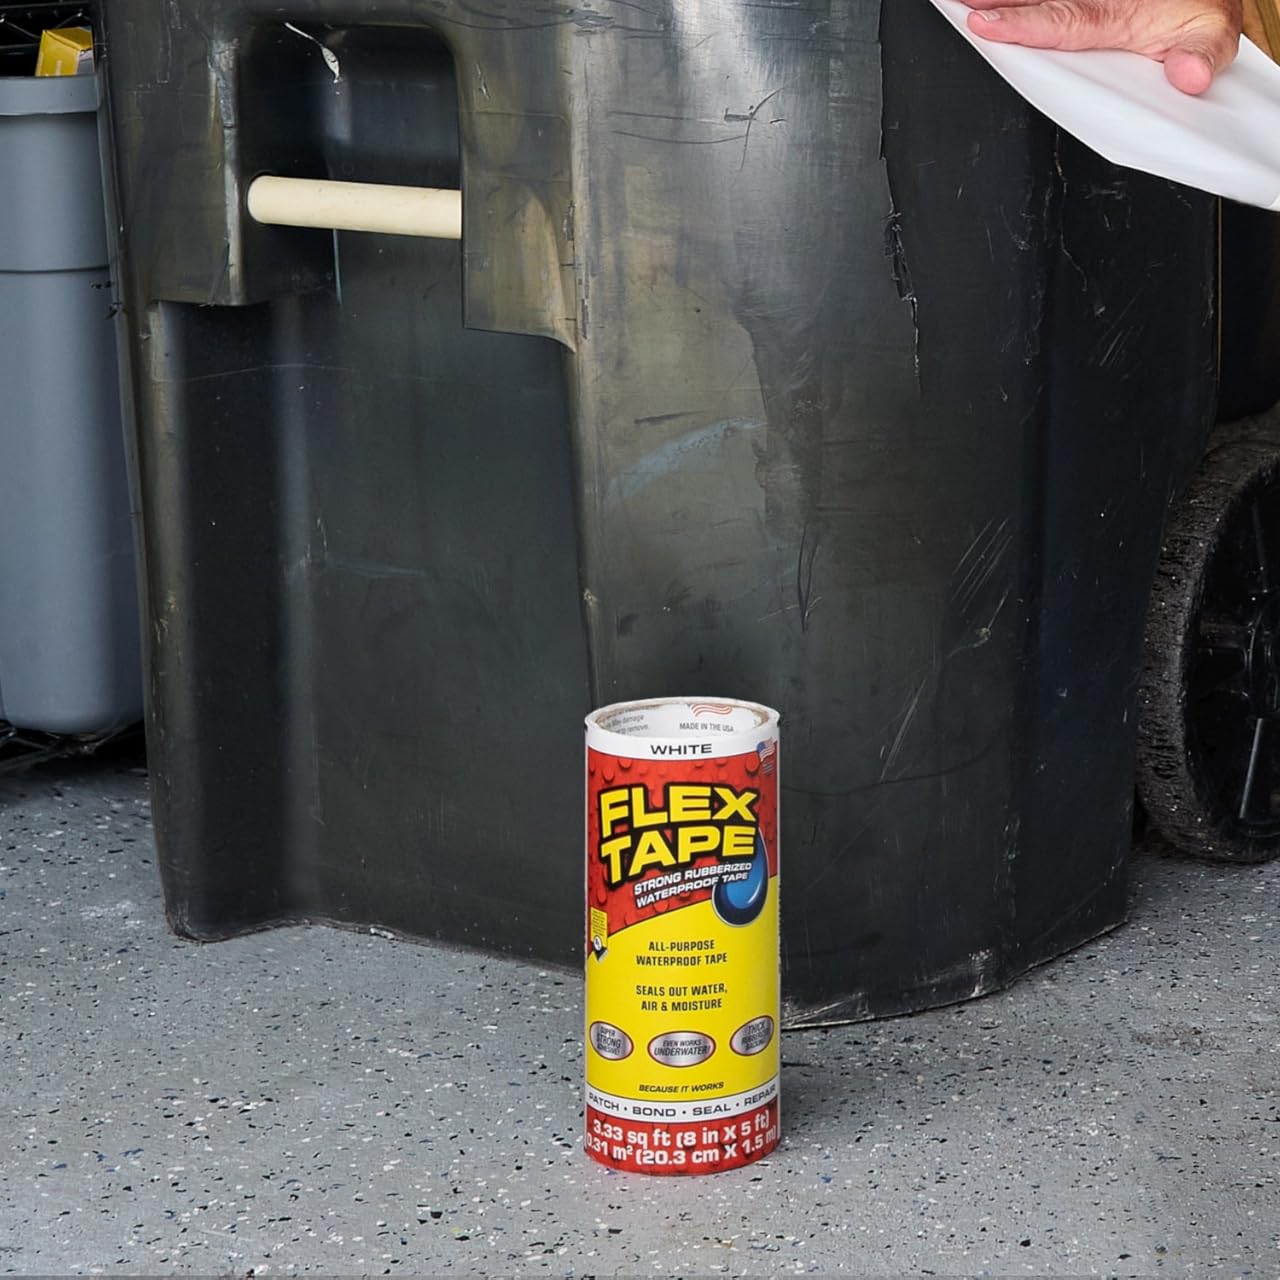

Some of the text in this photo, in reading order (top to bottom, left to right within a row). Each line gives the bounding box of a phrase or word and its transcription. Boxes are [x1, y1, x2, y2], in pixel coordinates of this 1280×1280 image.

[723, 724, 733, 732] USA
[651, 744, 712, 755] WHITE
[600, 786, 757, 838] FLEX
[601, 825, 756, 884] TAPE
[634, 862, 752, 895] STRONG RUBBERIZED
[636, 872, 748, 908] WATERPROOF TAPE
[649, 939, 715, 951] ALL-PURPOSE
[636, 954, 727, 966] WATERPROOF TAPE
[636, 983, 728, 996] SEALS OUT WATER,
[641, 998, 722, 1011] AIR & MOISTURE
[597, 1033, 621, 1049] STRONG
[639, 1084, 679, 1093] BECAUSE
[691, 1081, 724, 1092] WORKS
[588, 1084, 777, 1117] PATCH BOND SEAL REPAIR
[593, 1109, 769, 1149] 3.33 sq ft (8 in X 5 ft)
[636, 1148, 686, 1166] (20.3
[693, 1148, 719, 1162] cm
[724, 1144, 736, 1158] X
[742, 1132, 763, 1153] 1.5
